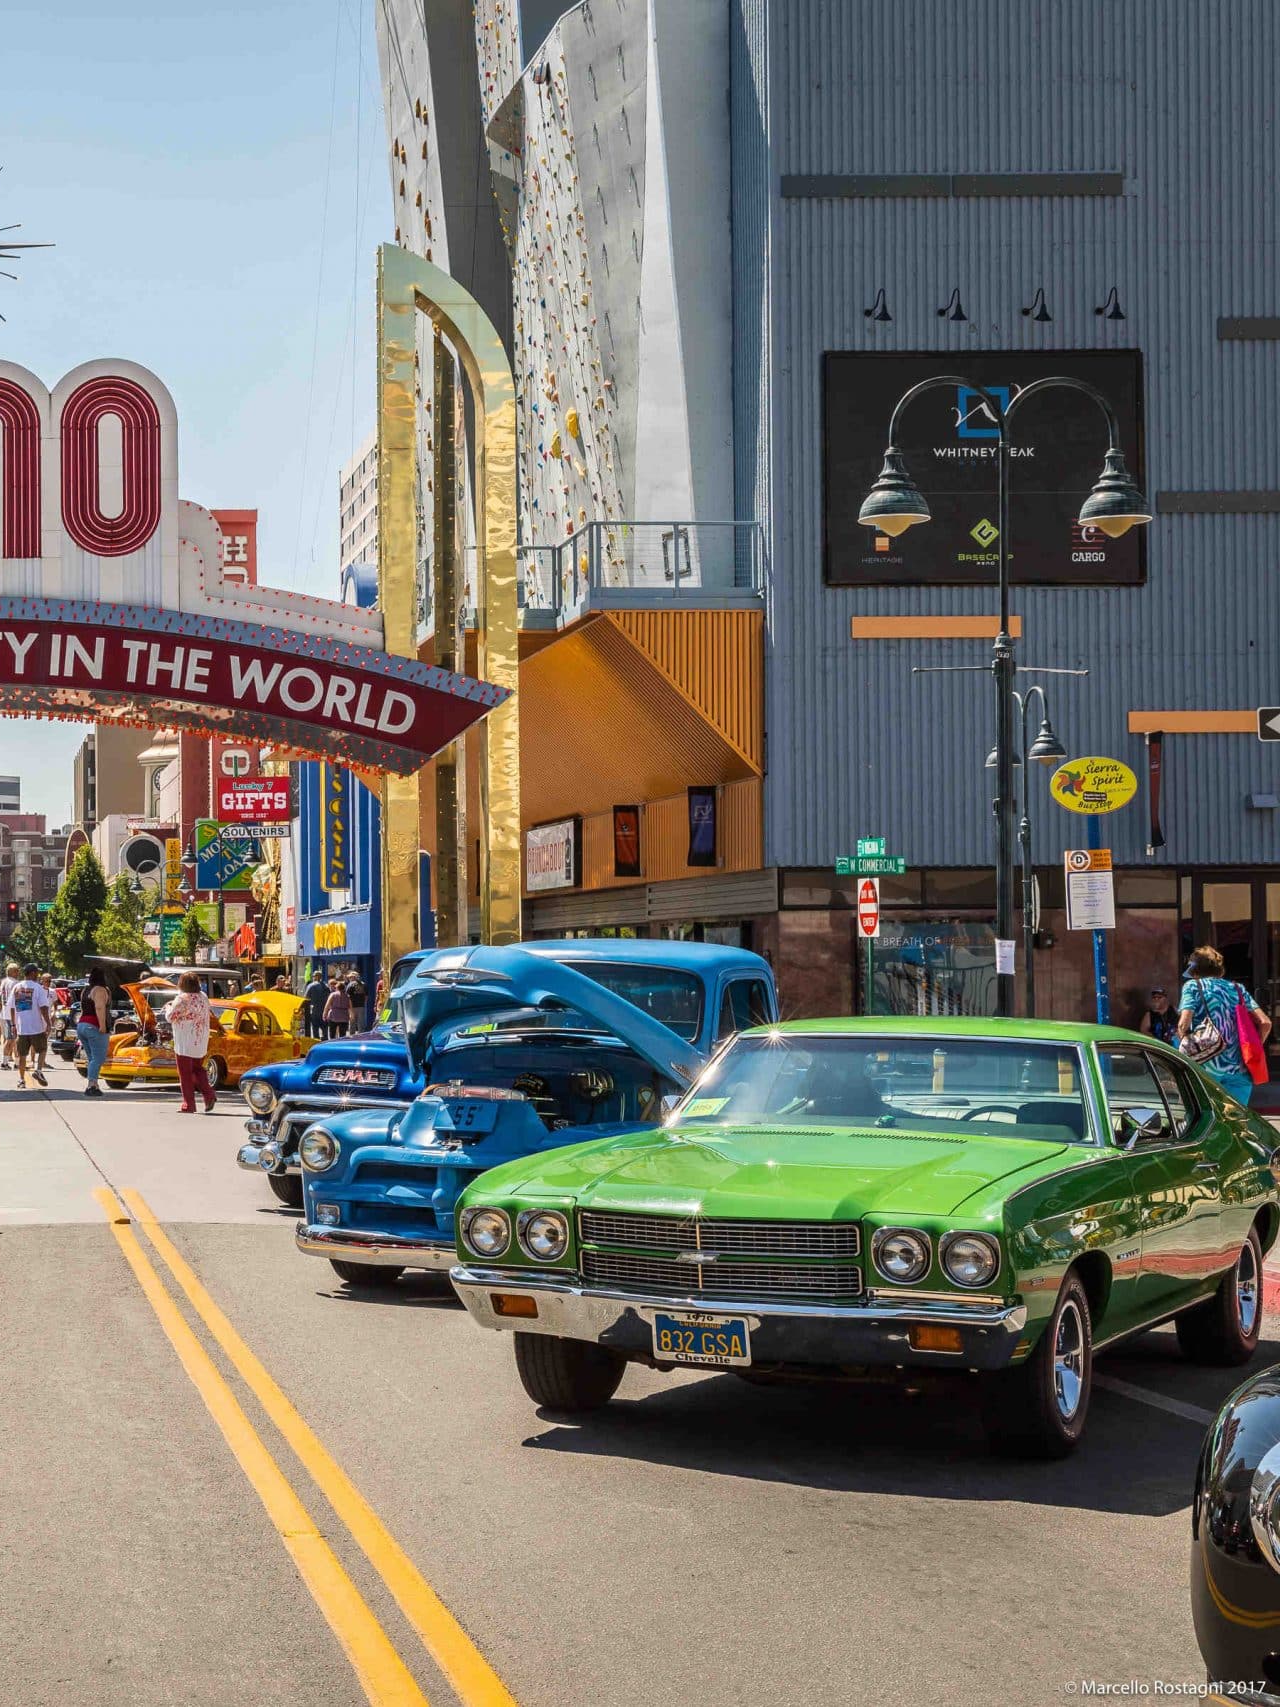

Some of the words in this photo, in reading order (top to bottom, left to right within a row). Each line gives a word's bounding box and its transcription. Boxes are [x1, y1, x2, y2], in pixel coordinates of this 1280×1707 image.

[933, 447, 996, 457] WHITNEY
[1007, 447, 1035, 457] EAK
[1072, 552, 1106, 562] CARGO
[49, 634, 104, 680] IN
[122, 639, 213, 694] THE
[229, 655, 417, 735] WORLD
[1085, 763, 1121, 775] Sierra
[233, 782, 264, 791] Lucky
[1091, 773, 1126, 789] Spirit
[221, 792, 287, 810] GIFTS
[224, 827, 285, 837] SOUVENIRS
[215, 858, 246, 882] LOA
[850, 859, 856, 872] W
[859, 858, 897, 873] COMMERCIAL
[883, 937, 921, 947] BREATH
[332, 1070, 379, 1082] GMC
[686, 1313, 714, 1322] 1970
[660, 1329, 696, 1354] 832
[701, 1332, 744, 1357] GSA
[675, 1353, 731, 1364] Chevelle
